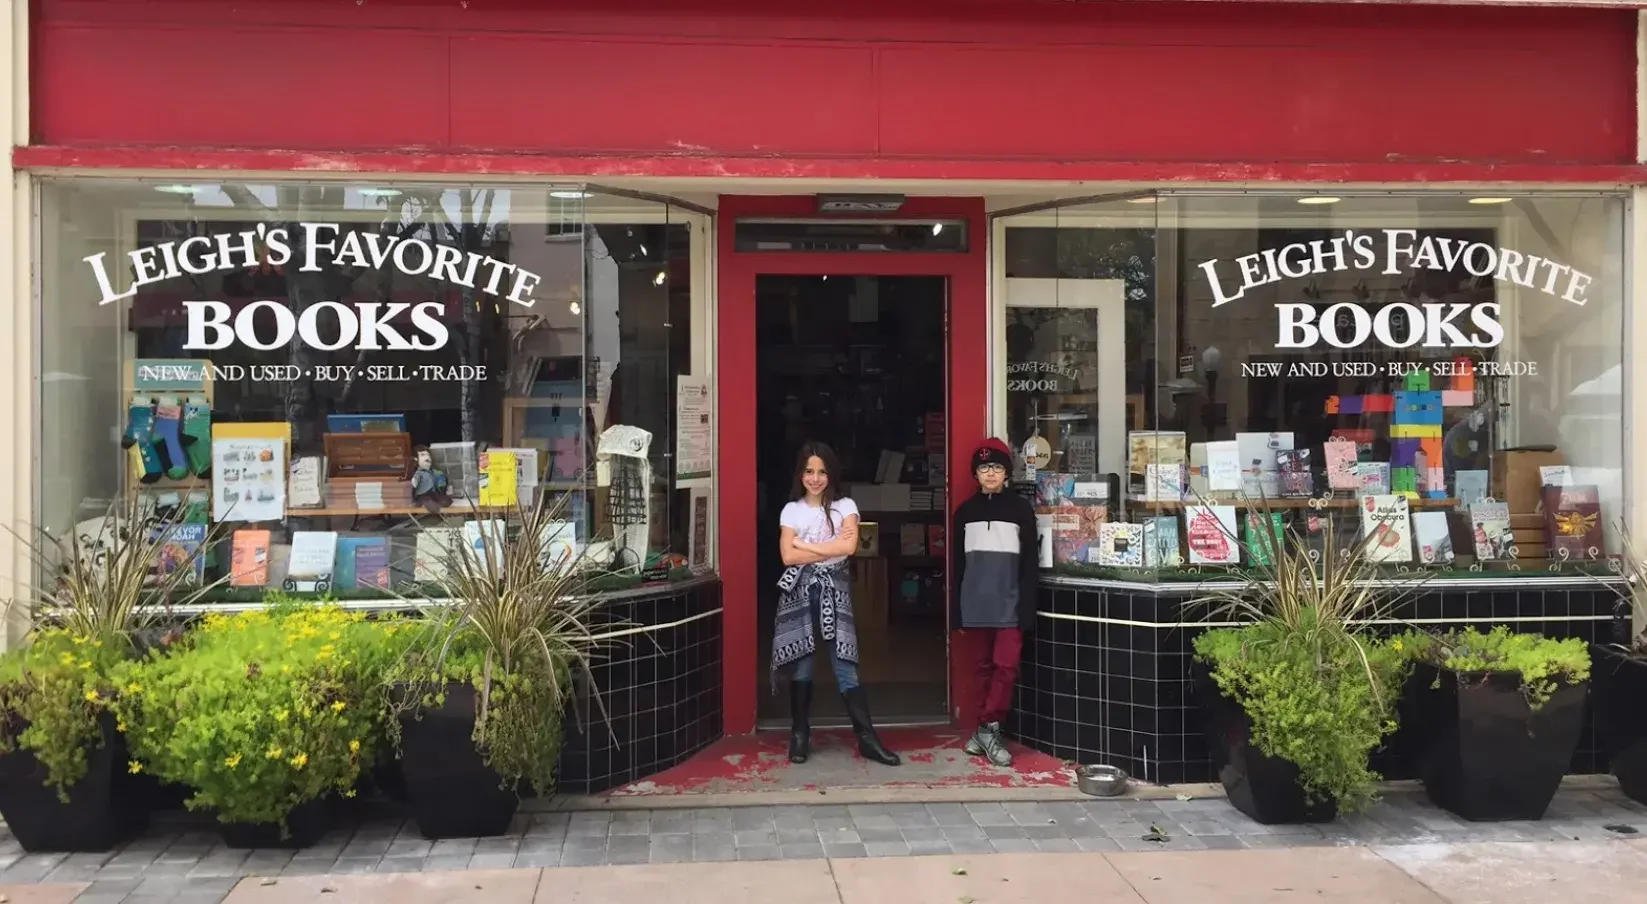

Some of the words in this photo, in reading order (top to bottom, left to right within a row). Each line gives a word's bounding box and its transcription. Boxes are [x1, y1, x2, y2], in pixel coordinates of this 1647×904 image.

[82, 223, 291, 305] LEIGH'S
[299, 222, 542, 307] FAVORITE
[1198, 229, 1375, 308] LEIGH'S
[1382, 229, 1592, 306] FAVORITE
[182, 300, 448, 351] BOOKS
[1274, 302, 1504, 348] BOOKS
[142, 365, 192, 382] NEW
[199, 365, 245, 382] AND
[250, 365, 300, 382] USED
[315, 365, 358, 382] BUY
[367, 365, 410, 382] SELL
[419, 365, 487, 382] TRADE
[1241, 362, 1283, 377] NEW
[1286, 362, 1328, 377] AND
[1332, 362, 1376, 377] USED
[1388, 362, 1422, 377] BUY
[1433, 362, 1473, 377] SELL
[1479, 362, 1538, 377] TRADE
